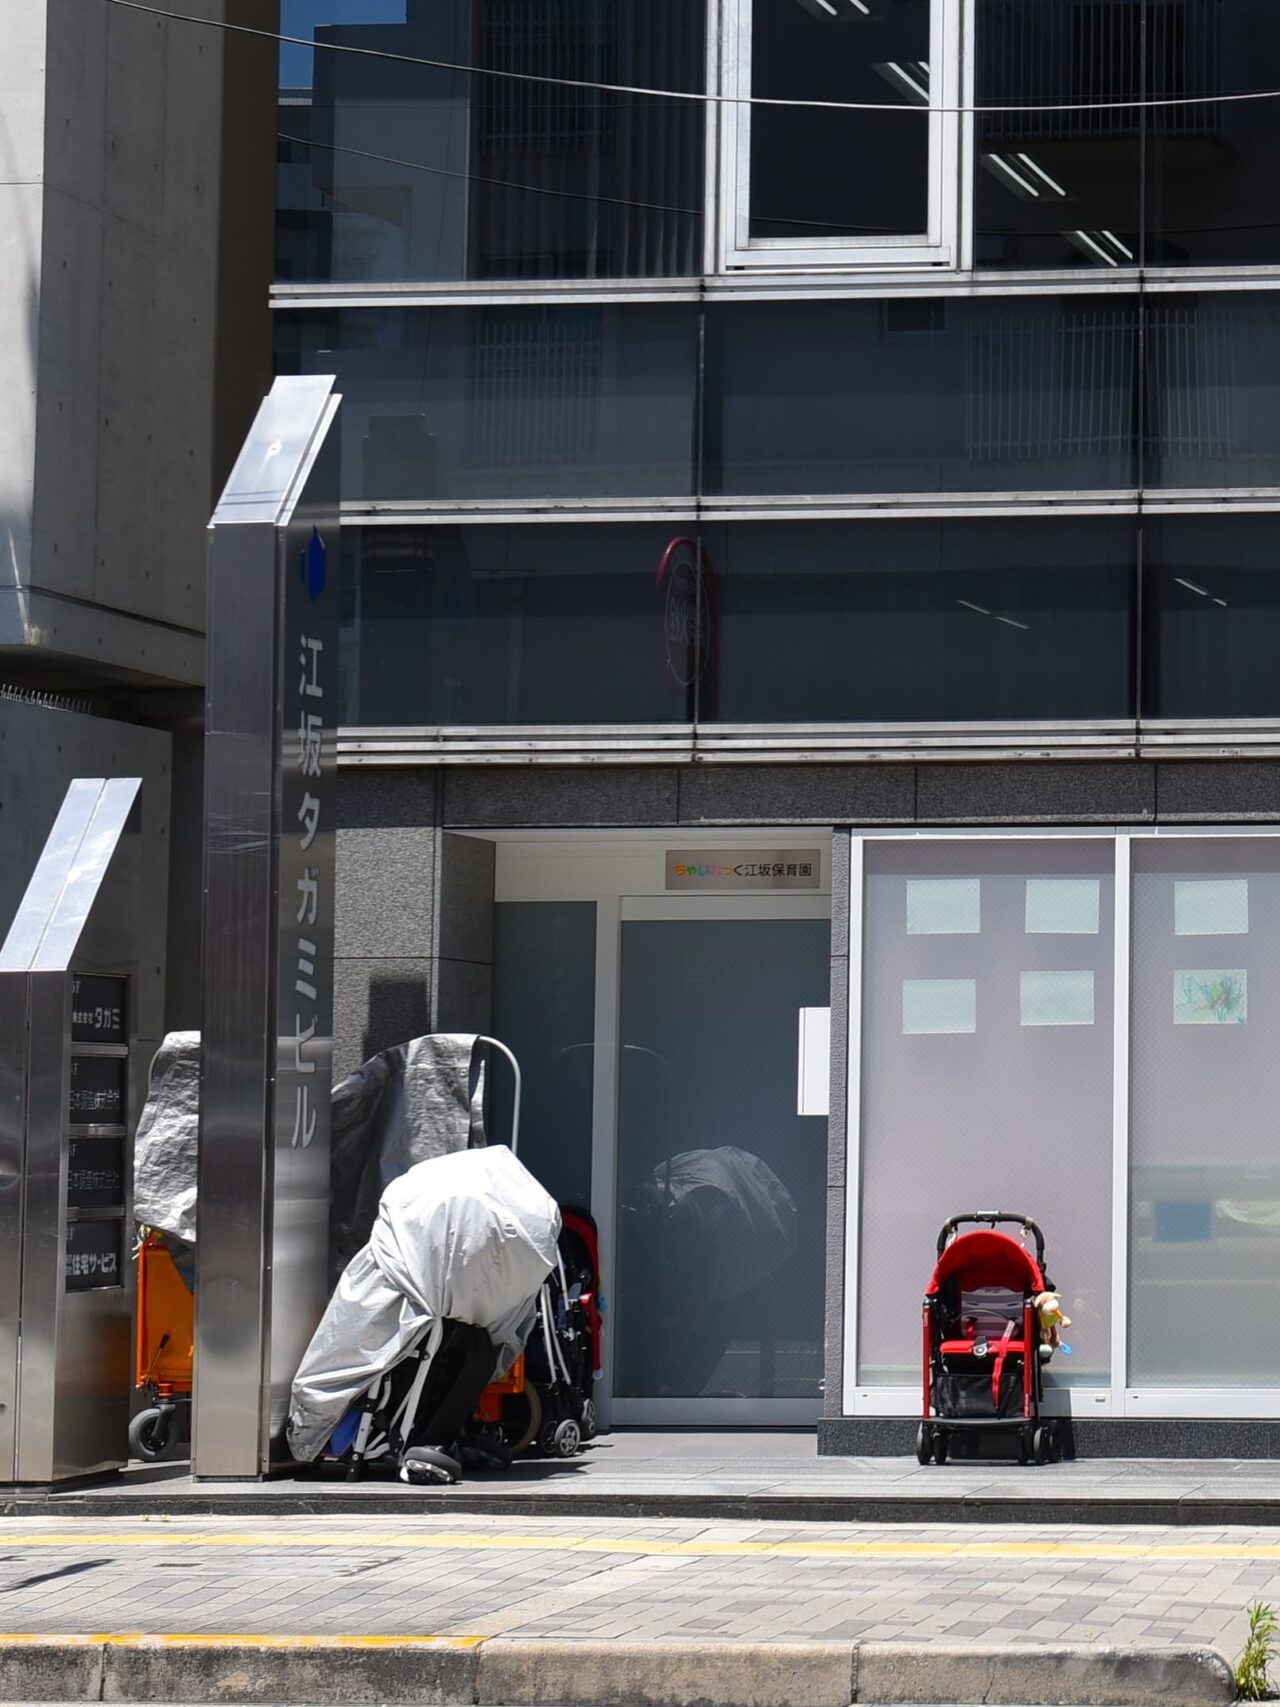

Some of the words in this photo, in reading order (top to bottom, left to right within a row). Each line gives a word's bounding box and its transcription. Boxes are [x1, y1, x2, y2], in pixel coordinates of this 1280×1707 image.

[291, 633, 324, 1150] 江坂タガミビル
